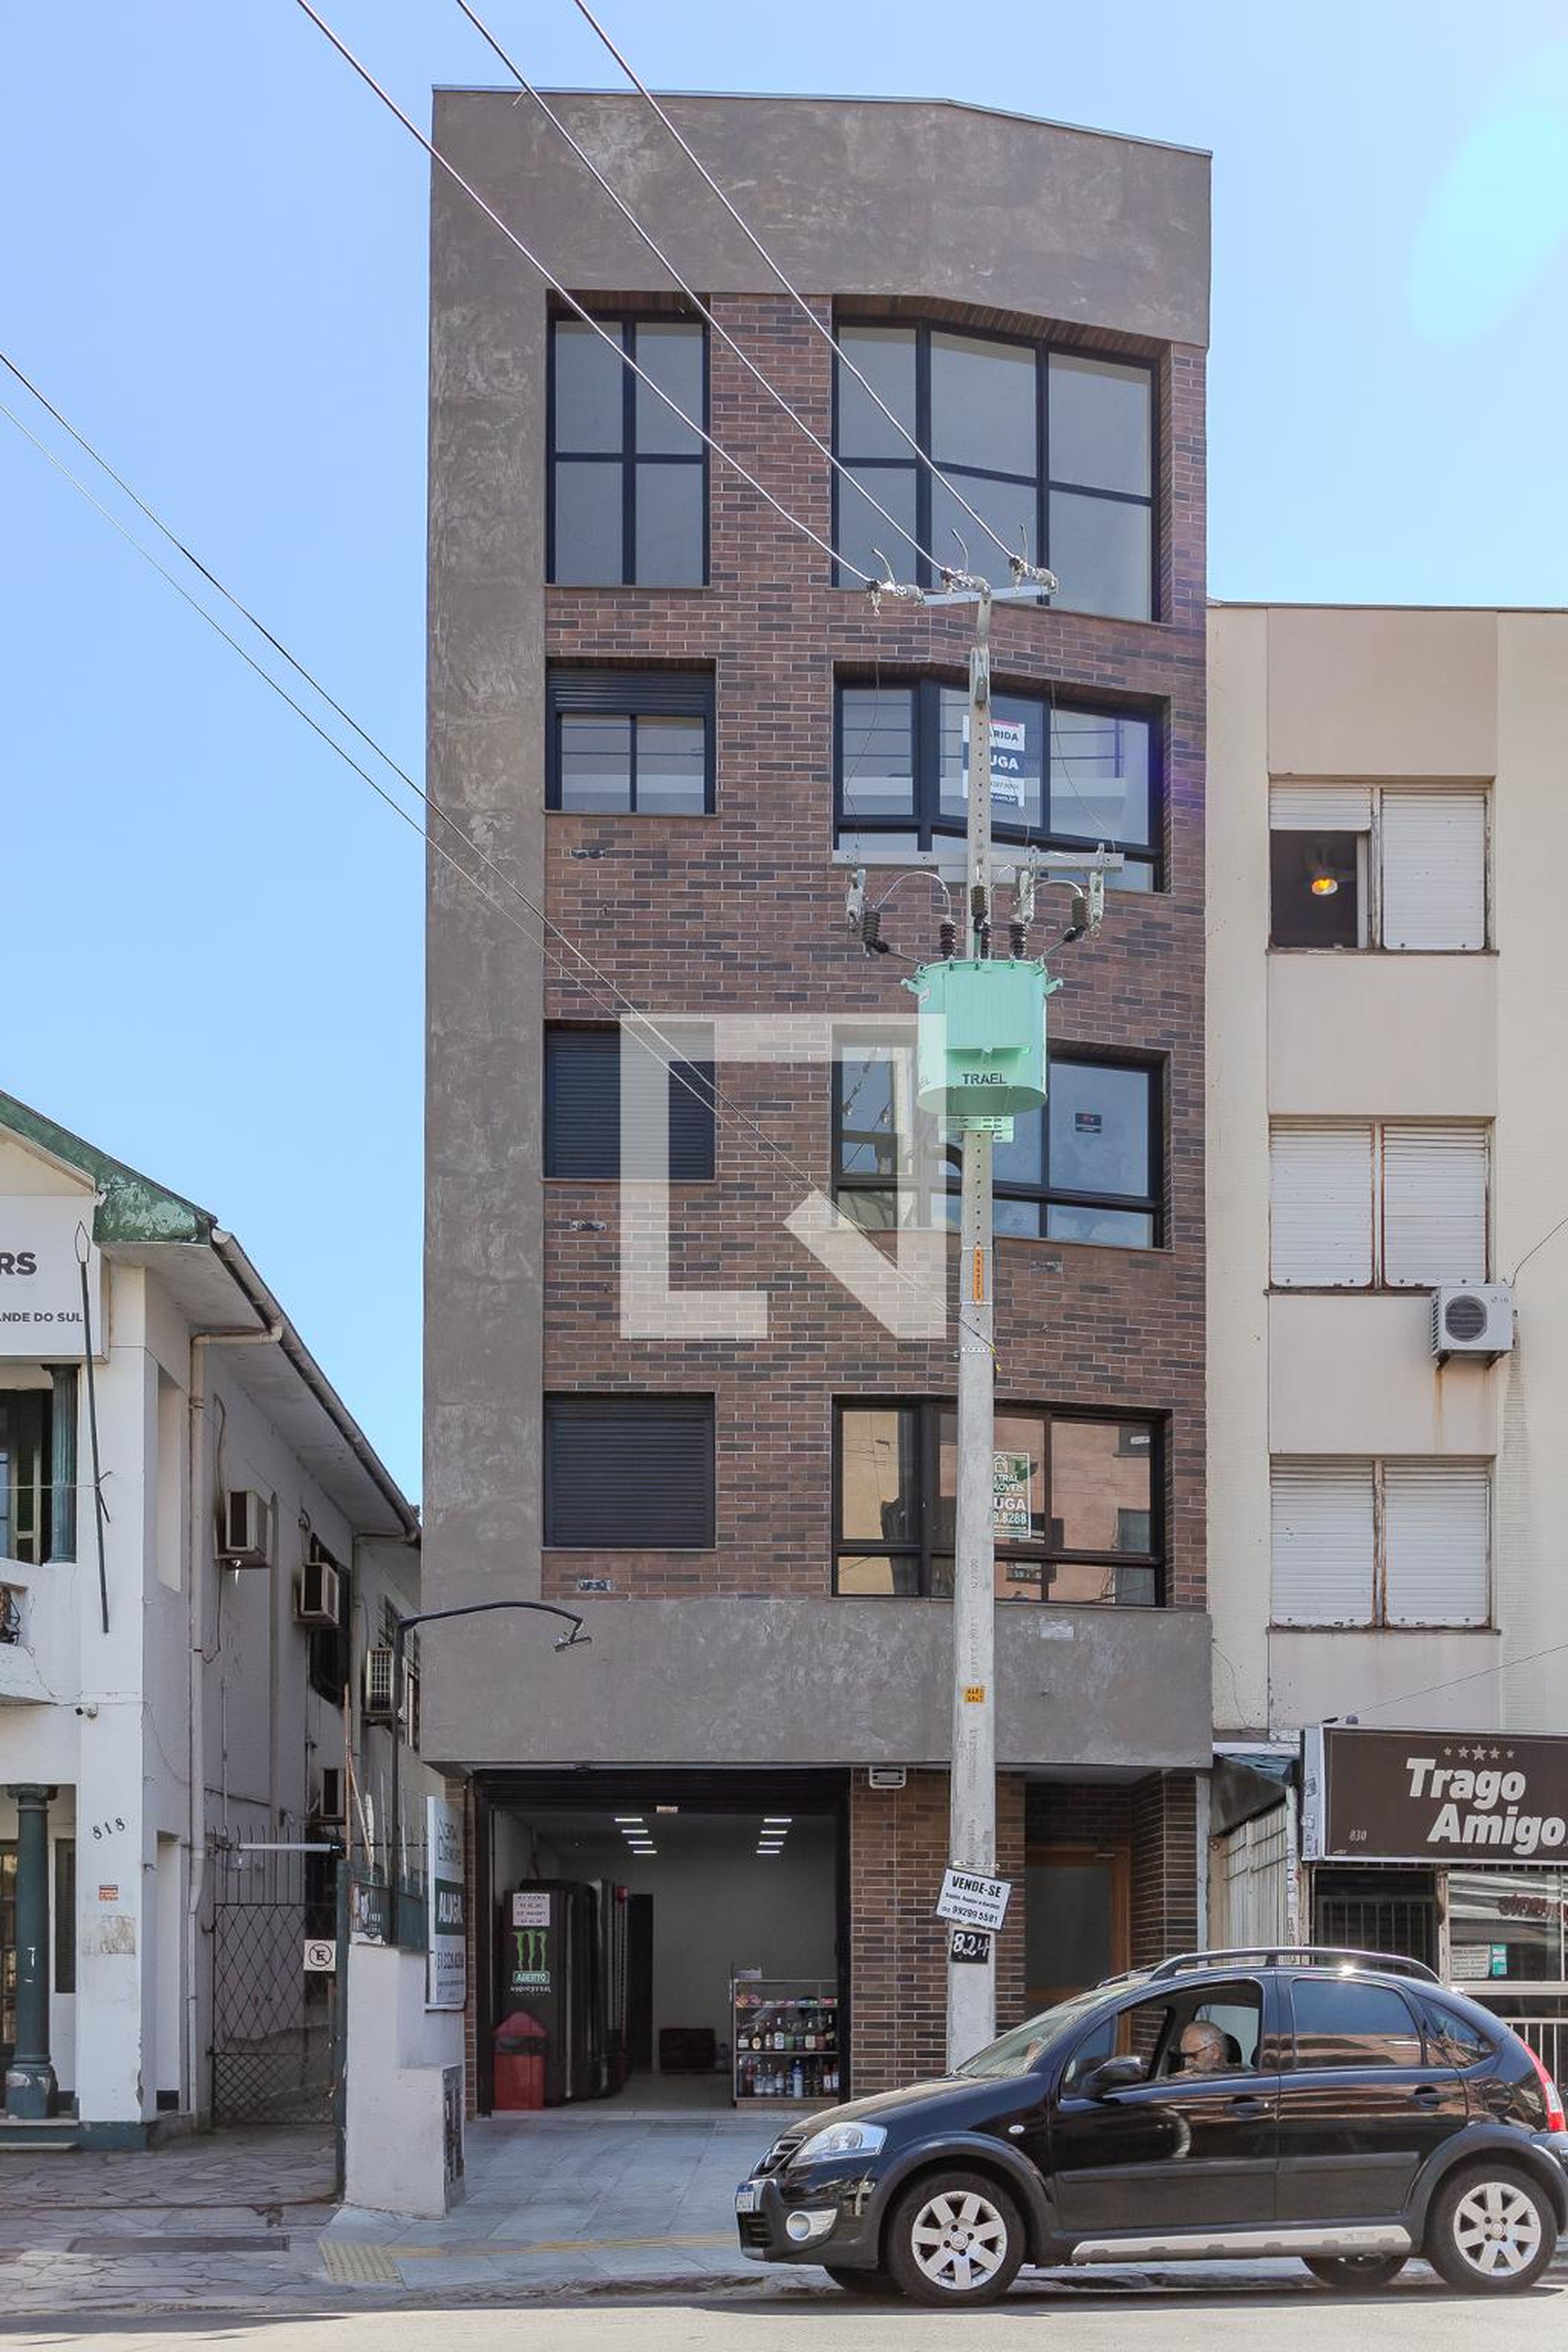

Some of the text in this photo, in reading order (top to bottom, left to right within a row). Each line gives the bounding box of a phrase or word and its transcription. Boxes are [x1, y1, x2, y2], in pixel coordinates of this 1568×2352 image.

[991, 730, 1018, 742] RIDA
[962, 1073, 1007, 1085] TRAEL
[0, 1312, 83, 1322] NDE DO SUL
[1406, 1757, 1526, 1810] Trago
[93, 1817, 125, 1840] 818
[952, 1876, 1002, 1898] VENDE-SE
[953, 1933, 989, 1957] 824
